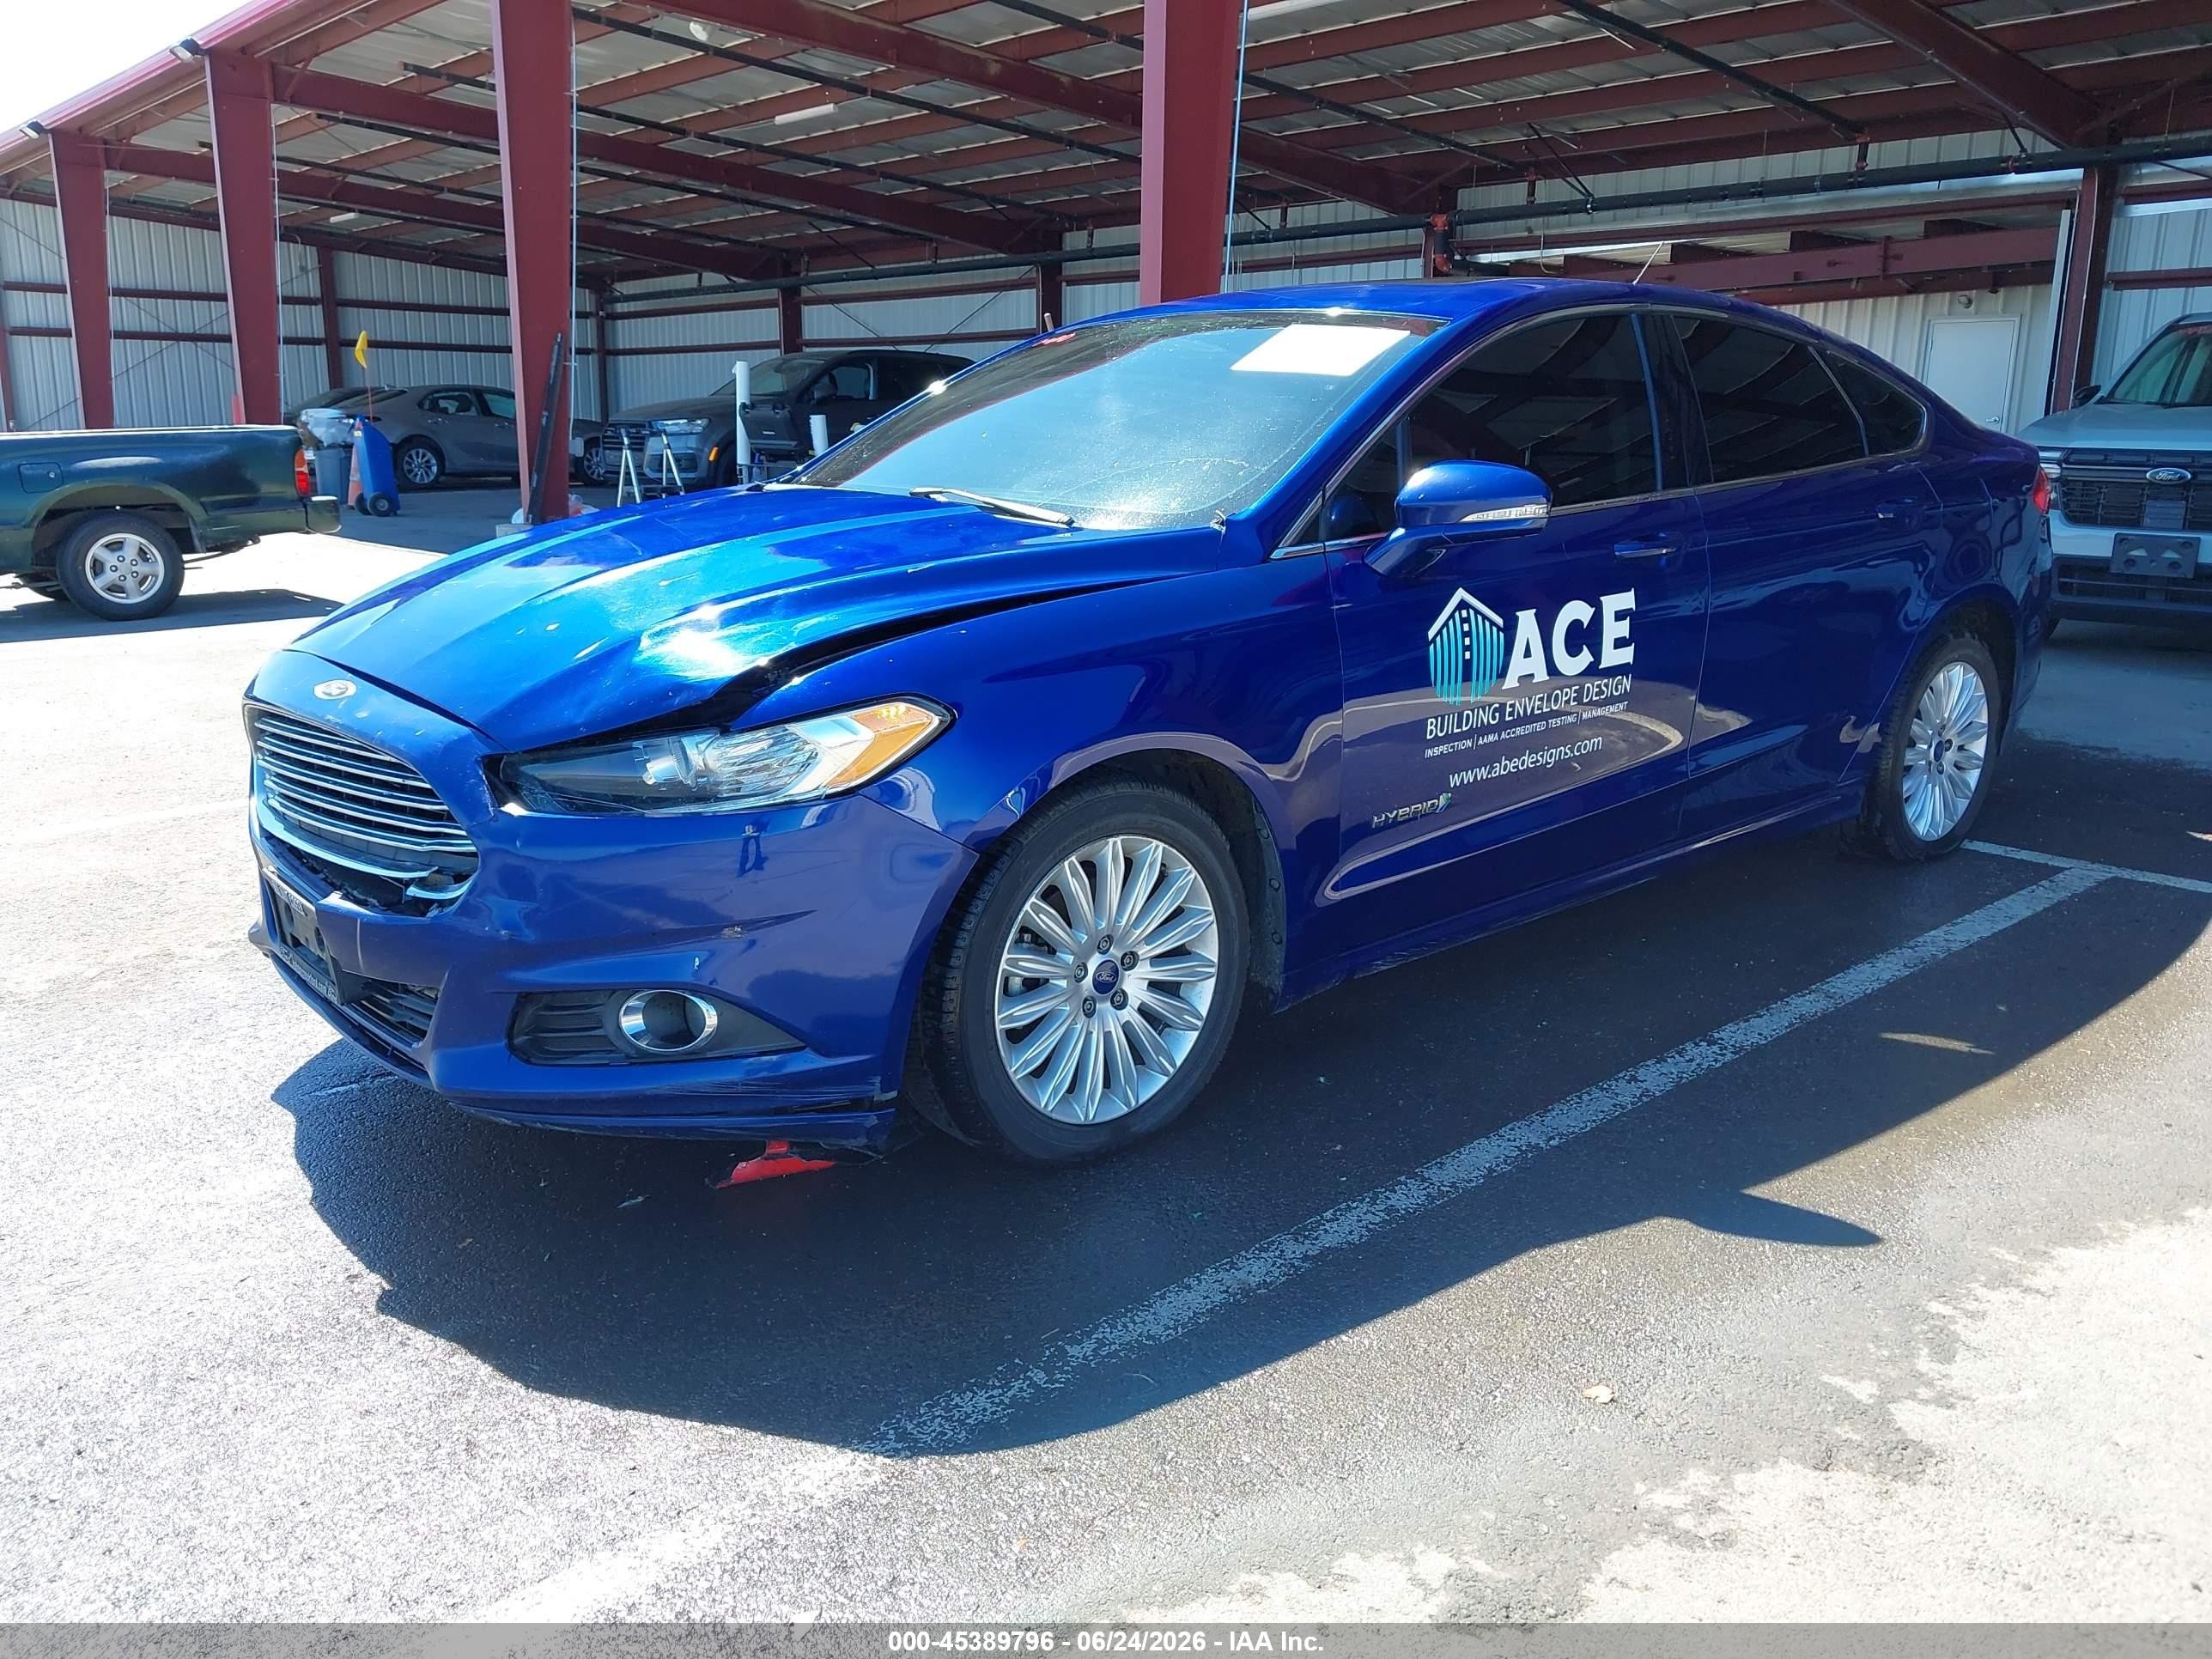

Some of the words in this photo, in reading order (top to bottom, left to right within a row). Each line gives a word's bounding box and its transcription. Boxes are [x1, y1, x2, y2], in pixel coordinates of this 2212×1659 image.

[1502, 587, 1636, 690] ACE
[1425, 738, 1473, 758] INSPECTION
[1477, 732, 1498, 746] AAMA
[1499, 720, 1547, 740] ACCREDITED
[1548, 714, 1577, 729] TESTING
[1582, 701, 1629, 720] MANAGEMENT
[1426, 703, 1500, 739] BUILDING
[1504, 685, 1580, 721] ENVELOPE
[1583, 673, 1632, 703] DESIGN
[1449, 736, 1603, 788] www.abedesigns.com
[1372, 799, 1441, 829] HYBRID
